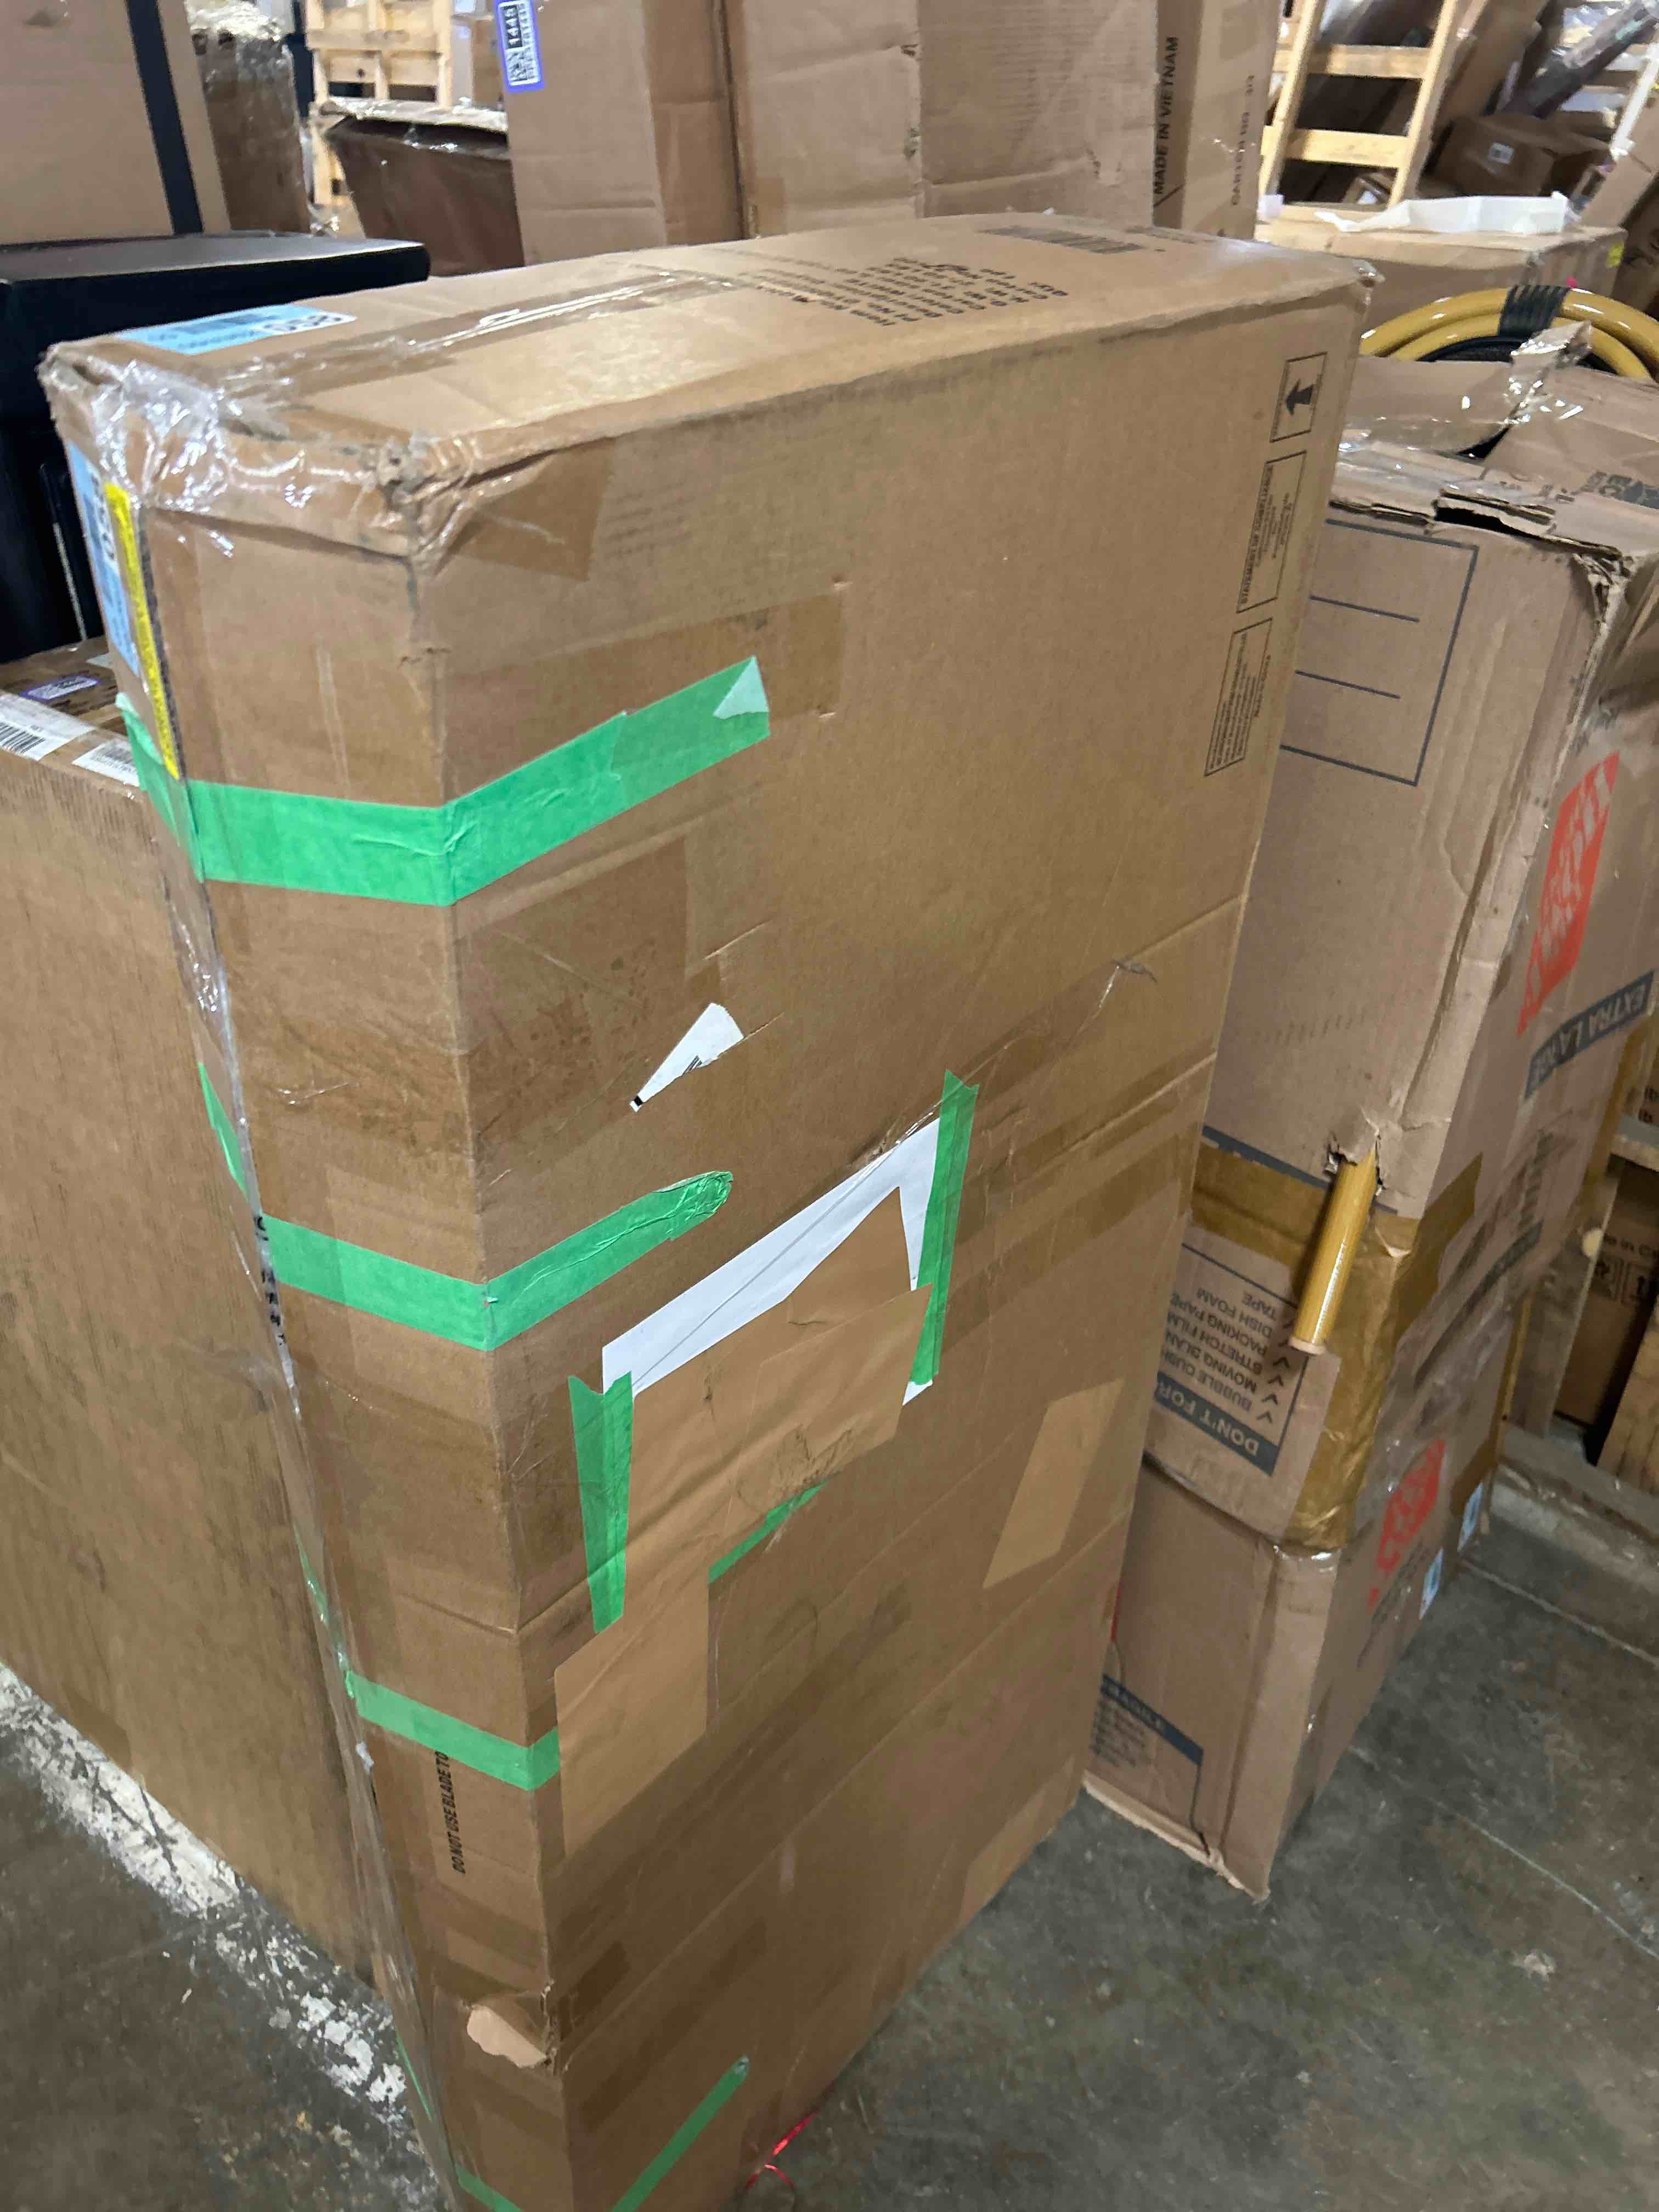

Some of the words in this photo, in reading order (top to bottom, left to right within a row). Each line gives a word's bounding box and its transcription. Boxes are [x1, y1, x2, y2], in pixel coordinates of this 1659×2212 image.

[1159, 36, 1178, 118] VIETNAM
[1158, 123, 1170, 140] IN
[1153, 145, 1169, 195] MADE
[1197, 1287, 1236, 1317] FOAM
[1242, 1290, 1276, 1321] TAPE
[1167, 1310, 1198, 1338] FILM
[1207, 1314, 1268, 1356] PACKING
[1238, 1311, 1273, 1339] DISH
[1200, 1329, 1262, 1375] STRETCH
[1204, 1353, 1257, 1393] MOVING
[1199, 1408, 1260, 1456] DON'T
[437, 1769, 456, 1808] BLADE
[442, 1806, 459, 1832] USE
[447, 1831, 462, 1858] NOT
[452, 1855, 466, 1874] DO
